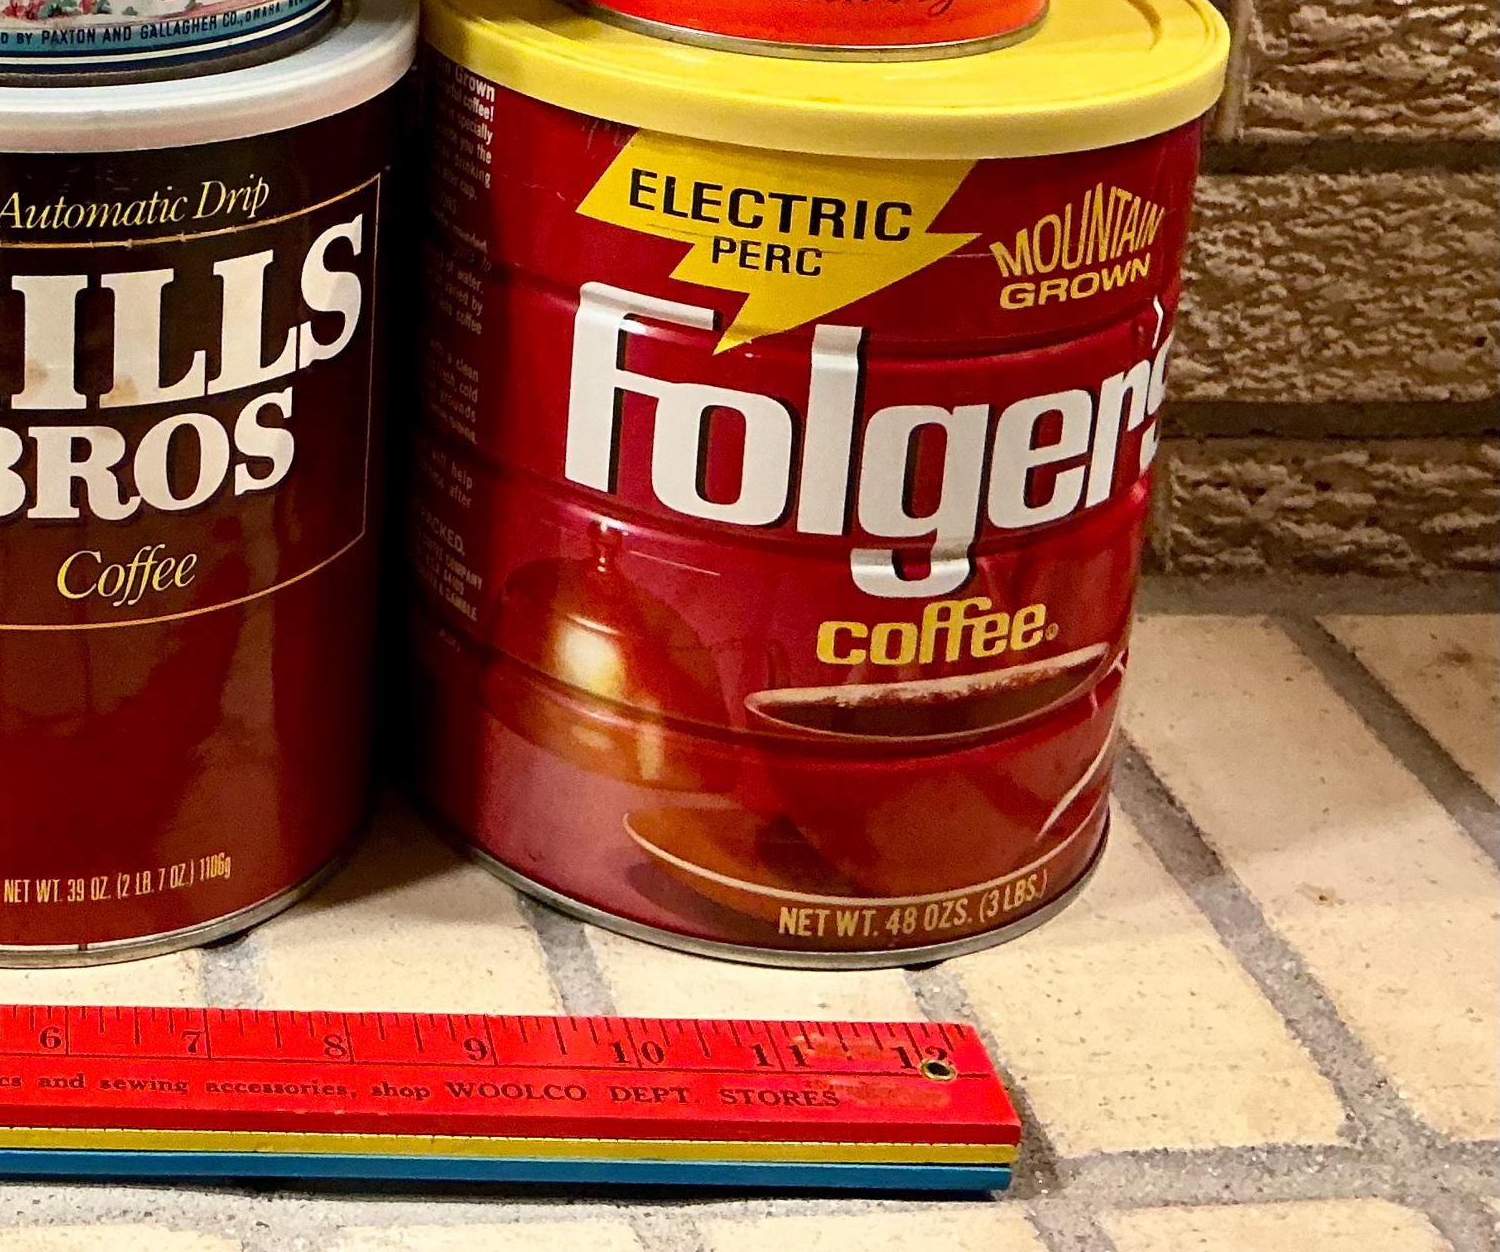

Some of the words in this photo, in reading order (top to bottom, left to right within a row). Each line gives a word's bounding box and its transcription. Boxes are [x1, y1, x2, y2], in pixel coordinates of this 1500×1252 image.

[16, 32, 33, 44] BY
[41, 29, 95, 44] PAXTON
[102, 26, 132, 43] AND
[140, 15, 217, 38] GALLAGHER
[192, 174, 270, 220] Drip
[629, 168, 912, 242] ELECTRIC
[990, 182, 1166, 277] MOUNTAIN
[711, 236, 823, 277] PERC
[999, 254, 1152, 310] GROWN
[57, 543, 198, 606] Coffee
[816, 597, 1047, 665] coffee
[4, 879, 30, 903] NET
[36, 879, 63, 903] WT.
[67, 879, 85, 902] 39
[90, 876, 112, 900] OZ.
[117, 872, 130, 899] (2
[135, 870, 155, 895] LB.
[158, 868, 166, 891] 7
[170, 859, 194, 889] OZ.)
[199, 852, 231, 881] 1106g
[779, 906, 829, 936] NET
[834, 910, 879, 937] WT.
[886, 910, 916, 934] 48
[923, 900, 974, 930] OZS.
[980, 892, 1000, 923] (3
[1003, 868, 1049, 912] LBS.)
[39, 1027, 63, 1050] 6
[181, 1030, 202, 1054] 7
[322, 1034, 348, 1058] 8
[464, 1036, 488, 1063] 9
[611, 1040, 665, 1065] 10
[37, 1071, 86, 1090] and
[100, 1076, 189, 1096] sewing
[205, 1079, 356, 1101] accessories,
[371, 1080, 431, 1102] shop
[445, 1081, 588, 1103] WOOLCO
[718, 1088, 840, 1107] STORES
